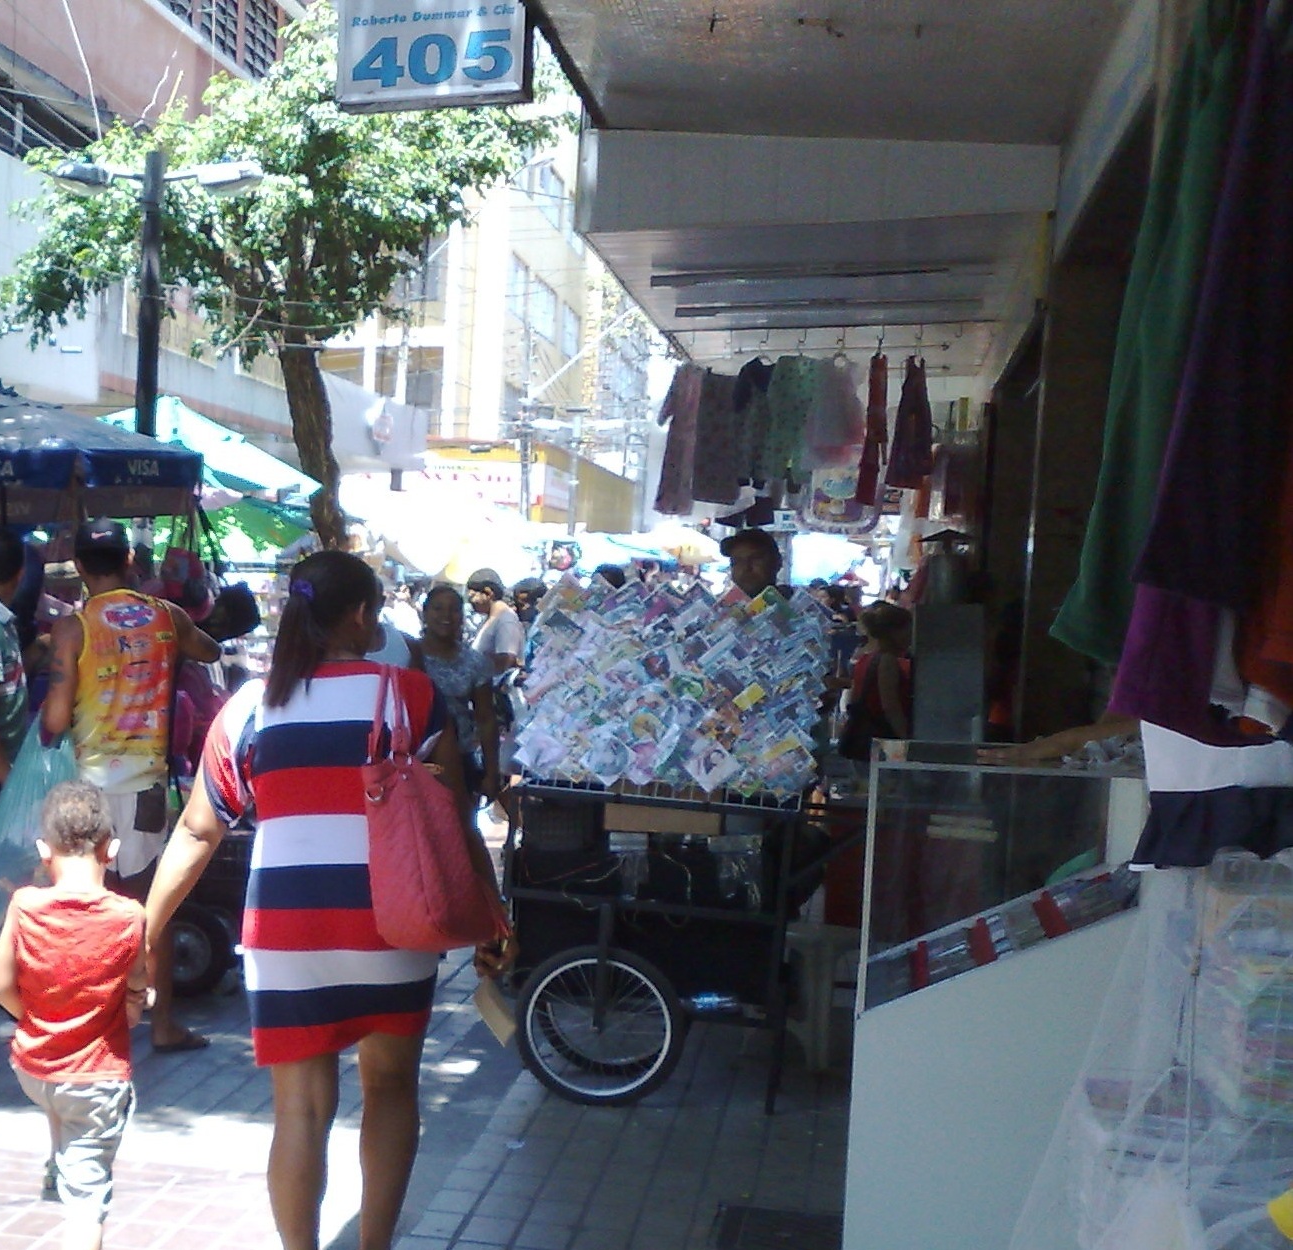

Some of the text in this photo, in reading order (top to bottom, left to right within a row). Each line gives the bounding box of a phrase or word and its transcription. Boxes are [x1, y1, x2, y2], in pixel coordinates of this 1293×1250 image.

[477, 6, 487, 16] &
[494, 4, 514, 15] Cia
[352, 29, 513, 88] 405
[126, 459, 160, 476] VISA
